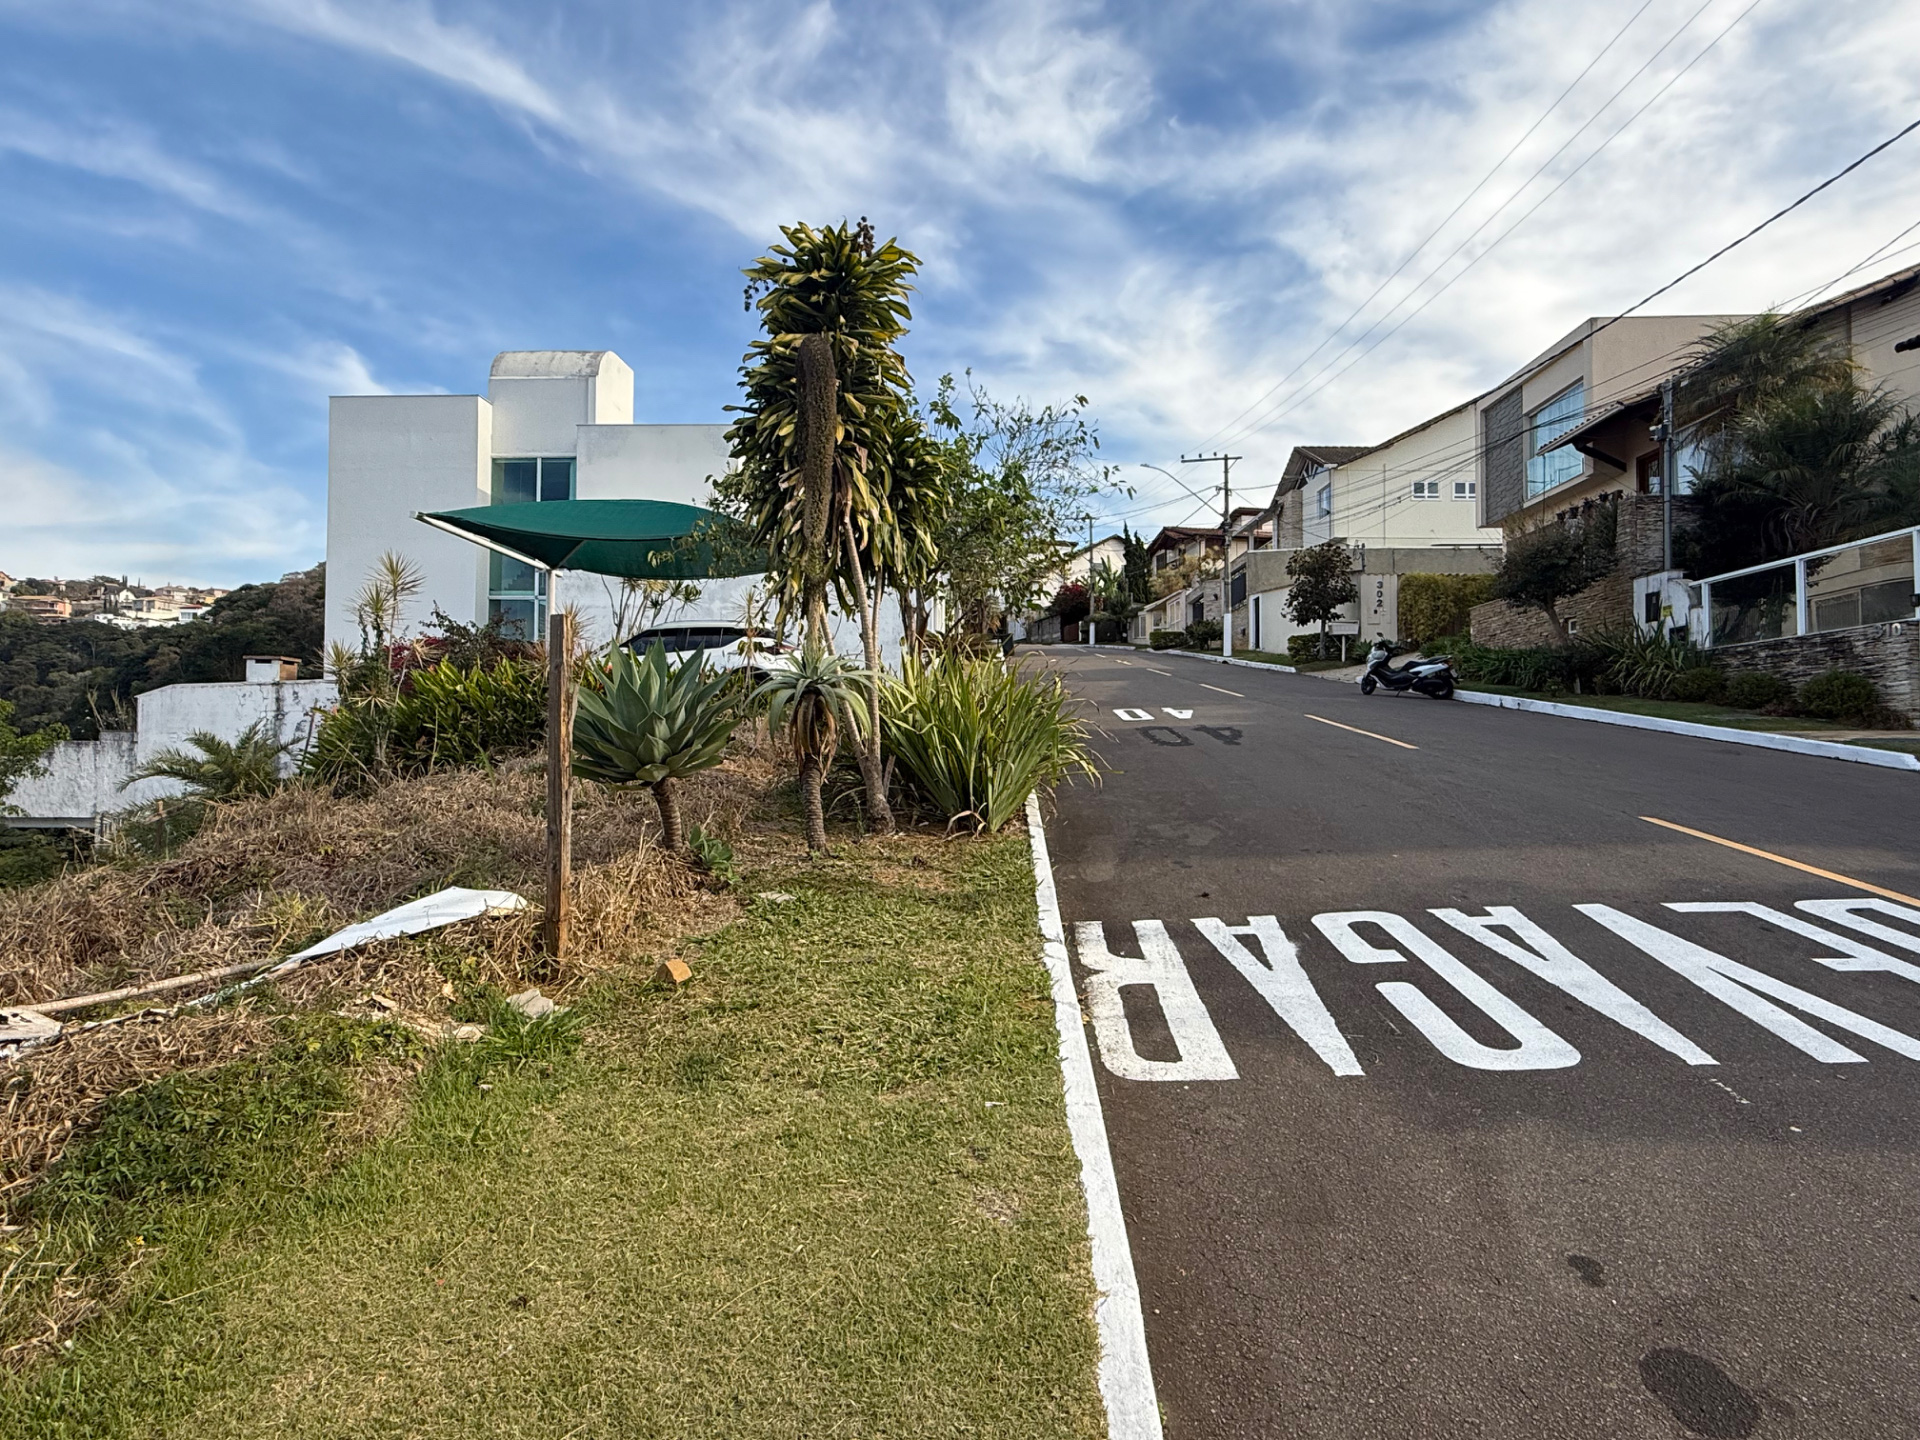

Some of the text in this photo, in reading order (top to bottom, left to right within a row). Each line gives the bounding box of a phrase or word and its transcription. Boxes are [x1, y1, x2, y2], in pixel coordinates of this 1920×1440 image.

[1376, 580, 1384, 608] 302
[1112, 707, 1194, 721] 40
[1073, 898, 1920, 1082] EVAGAR
